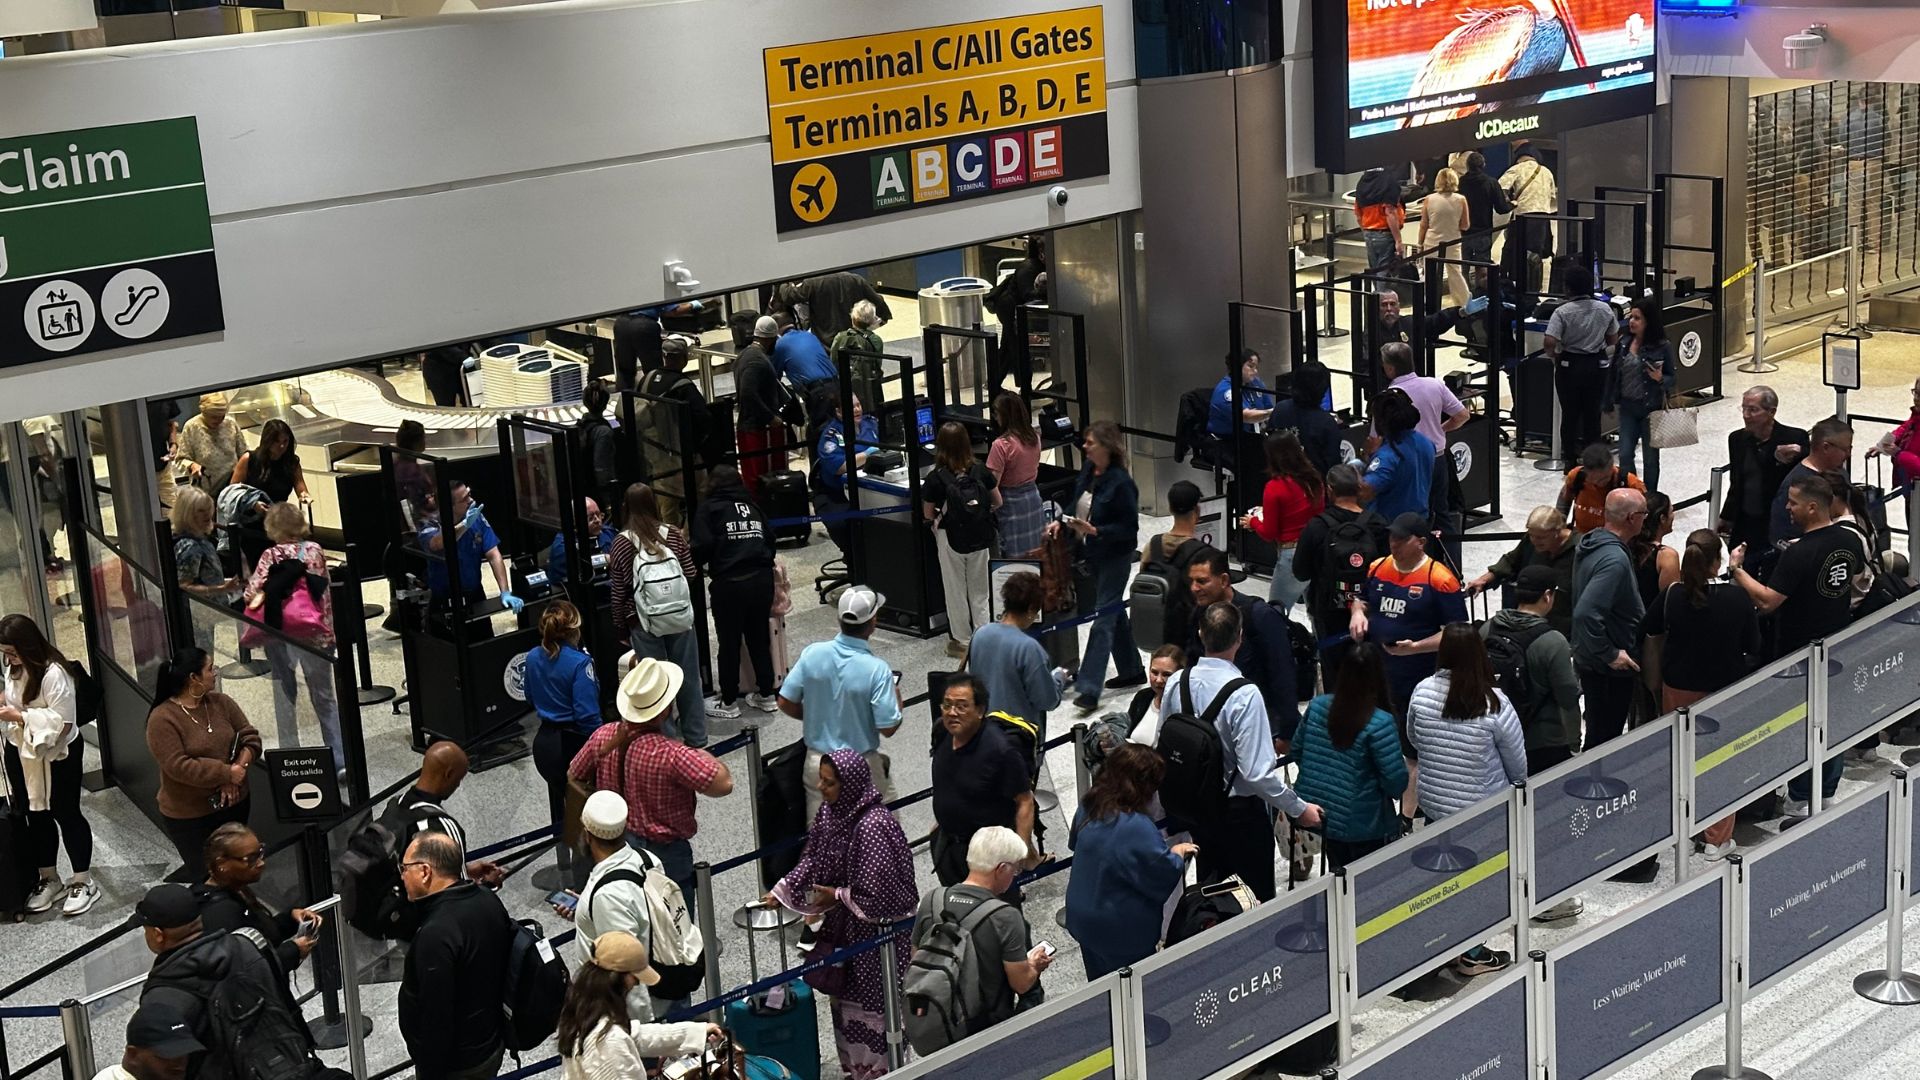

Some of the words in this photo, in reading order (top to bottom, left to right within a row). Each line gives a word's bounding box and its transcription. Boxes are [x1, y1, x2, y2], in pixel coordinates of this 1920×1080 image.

[780, 39, 923, 92] Terminal
[932, 29, 1002, 70] C/All
[1010, 25, 1093, 60] Gates
[785, 95, 948, 149] Terminals
[958, 90, 989, 125] A,
[1000, 84, 1027, 118] B,
[1036, 78, 1066, 112] D,
[1075, 72, 1092, 104] E
[1475, 115, 1539, 140] JCDecaux
[0, 143, 131, 195] Claim
[876, 156, 905, 197] A
[917, 150, 943, 188] B
[956, 143, 983, 181] C
[995, 137, 1021, 175] D
[1033, 130, 1057, 169] E
[877, 195, 907, 206] TERMINAL
[917, 189, 946, 199] TERMINAL
[957, 182, 985, 193] TERMINAL
[995, 175, 1023, 185] TERMINAL
[1033, 168, 1060, 178] TERMINAL
[1380, 596, 1407, 614] KUB
[1873, 652, 1904, 677] CLEAR
[284, 759, 299, 767] Exit
[300, 758, 317, 766] only
[300, 768, 323, 776] salida
[1596, 789, 1637, 819] CLEAR
[1408, 891, 1441, 913] Welcome
[1442, 881, 1460, 896] Back
[1228, 966, 1282, 1002] CLEAR
[1265, 982, 1283, 996] PLUS
[1593, 994, 1611, 1010] Less
[1643, 967, 1663, 984] More
[1664, 954, 1687, 973] Doing
